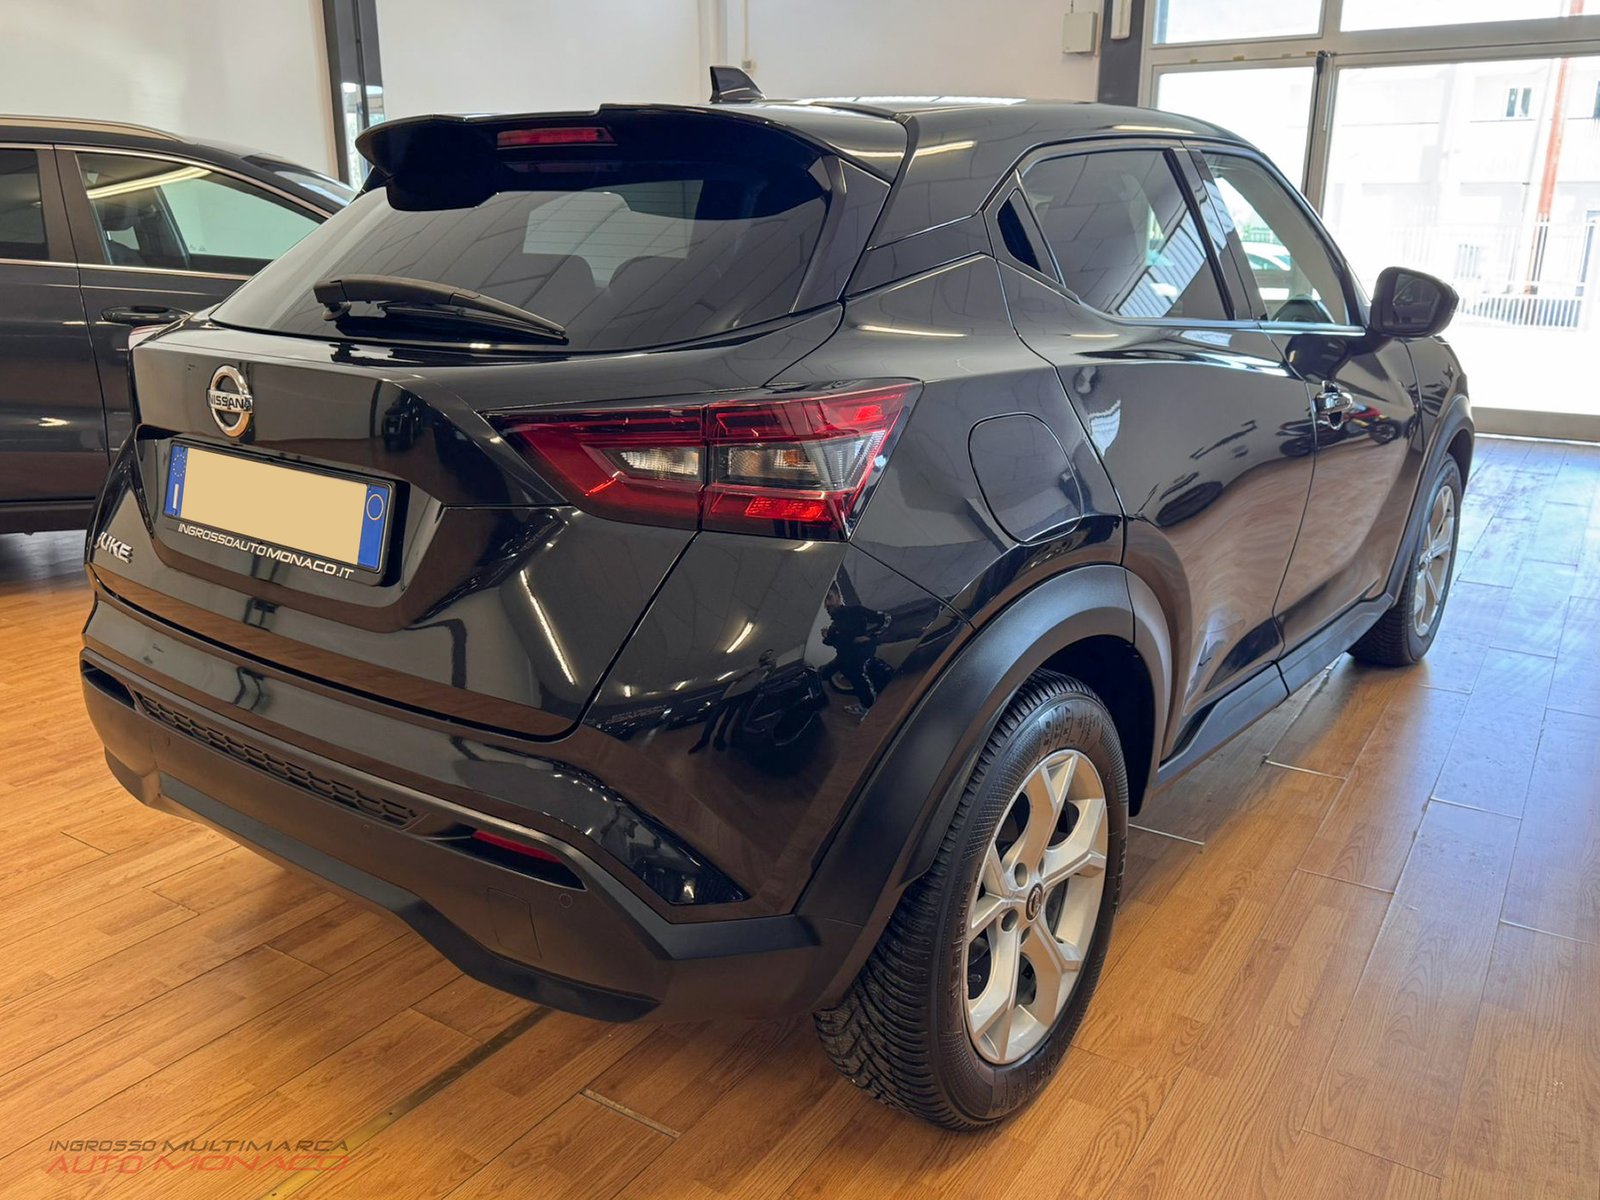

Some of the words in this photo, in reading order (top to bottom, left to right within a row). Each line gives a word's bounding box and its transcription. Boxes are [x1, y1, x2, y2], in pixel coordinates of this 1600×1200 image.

[209, 394, 244, 410] NISSAN
[93, 531, 133, 564] JUKE
[177, 522, 355, 580] INGROSSOAUTOMONACO.IT
